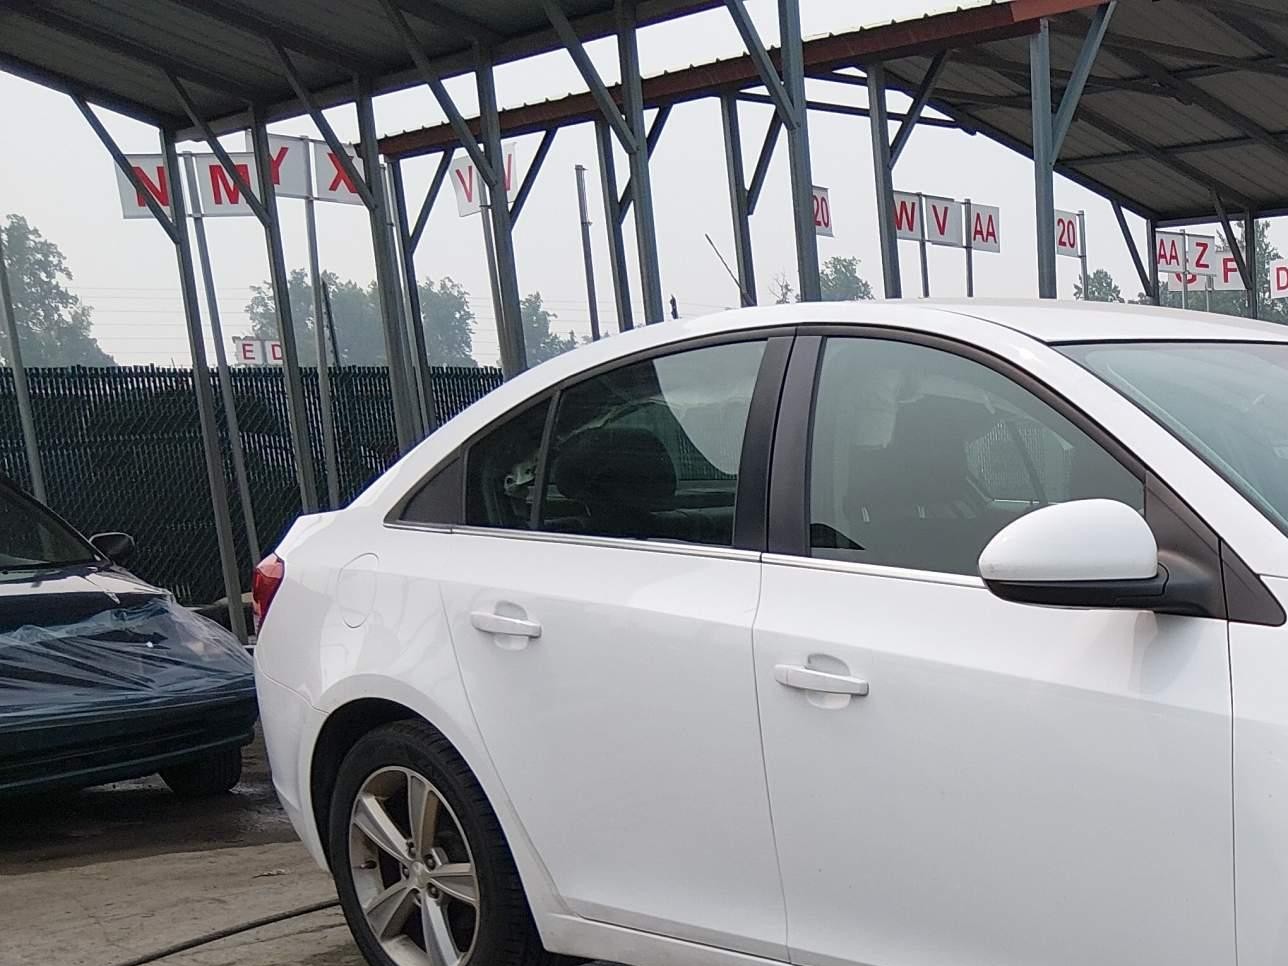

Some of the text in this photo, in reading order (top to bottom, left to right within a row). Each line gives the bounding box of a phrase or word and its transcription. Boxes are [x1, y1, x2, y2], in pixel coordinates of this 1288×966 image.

[131, 163, 251, 207] N M
[327, 152, 359, 194] X
[456, 165, 473, 203] V
[812, 198, 830, 228] 20
[893, 200, 997, 244] W V AA
[1057, 217, 1076, 249] 20
[1157, 238, 1210, 269] AA Z
[1222, 257, 1238, 284] F
[242, 343, 256, 360] E
